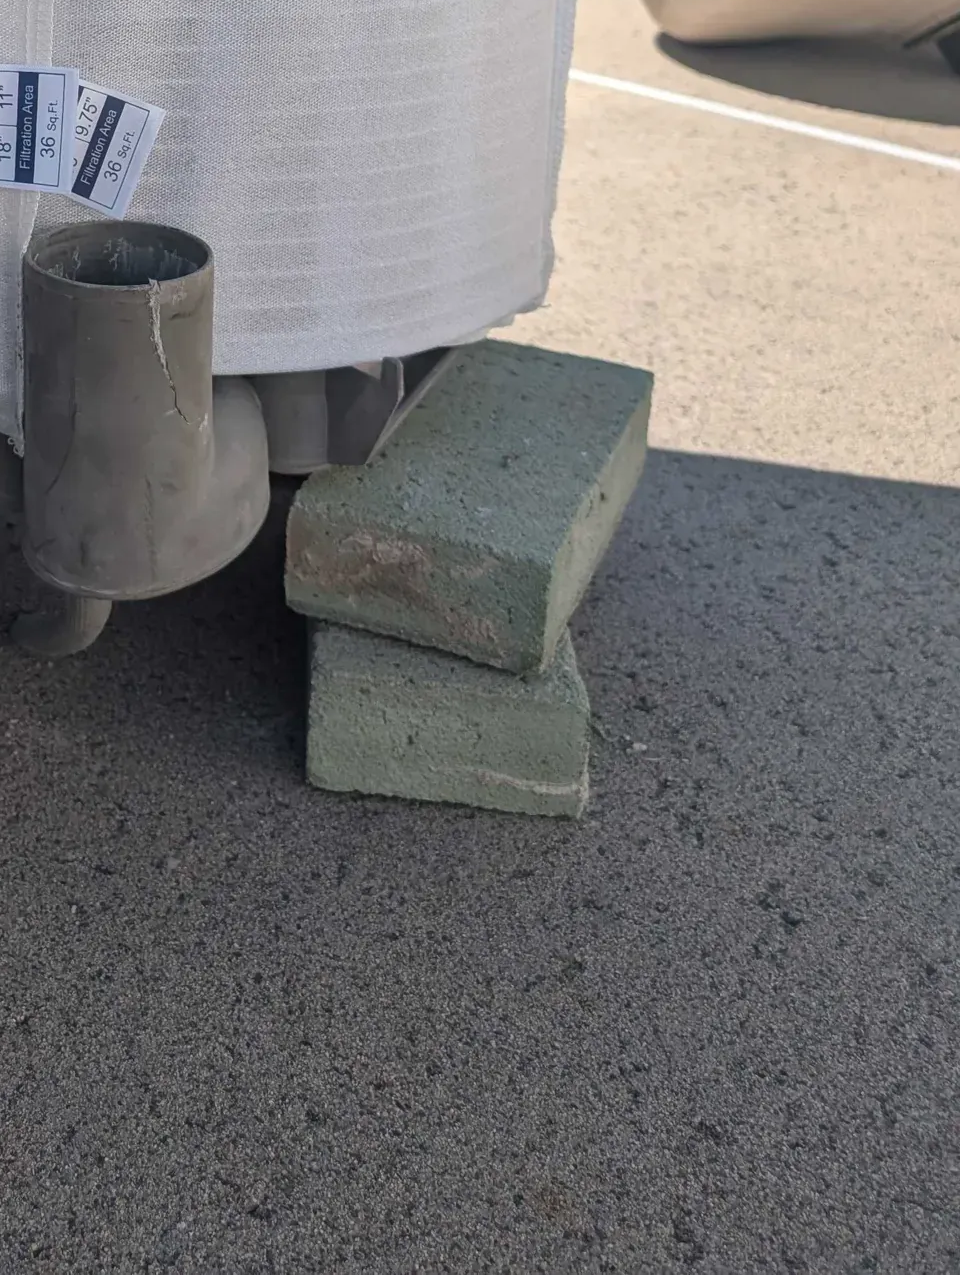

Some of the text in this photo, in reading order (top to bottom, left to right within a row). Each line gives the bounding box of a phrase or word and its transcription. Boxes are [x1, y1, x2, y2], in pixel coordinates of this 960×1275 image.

[19, 85, 34, 170] Filtration Area
[39, 100, 59, 158] 36 Sq.Ft.
[81, 109, 118, 185] Filtration Area
[103, 160, 121, 182] 36
